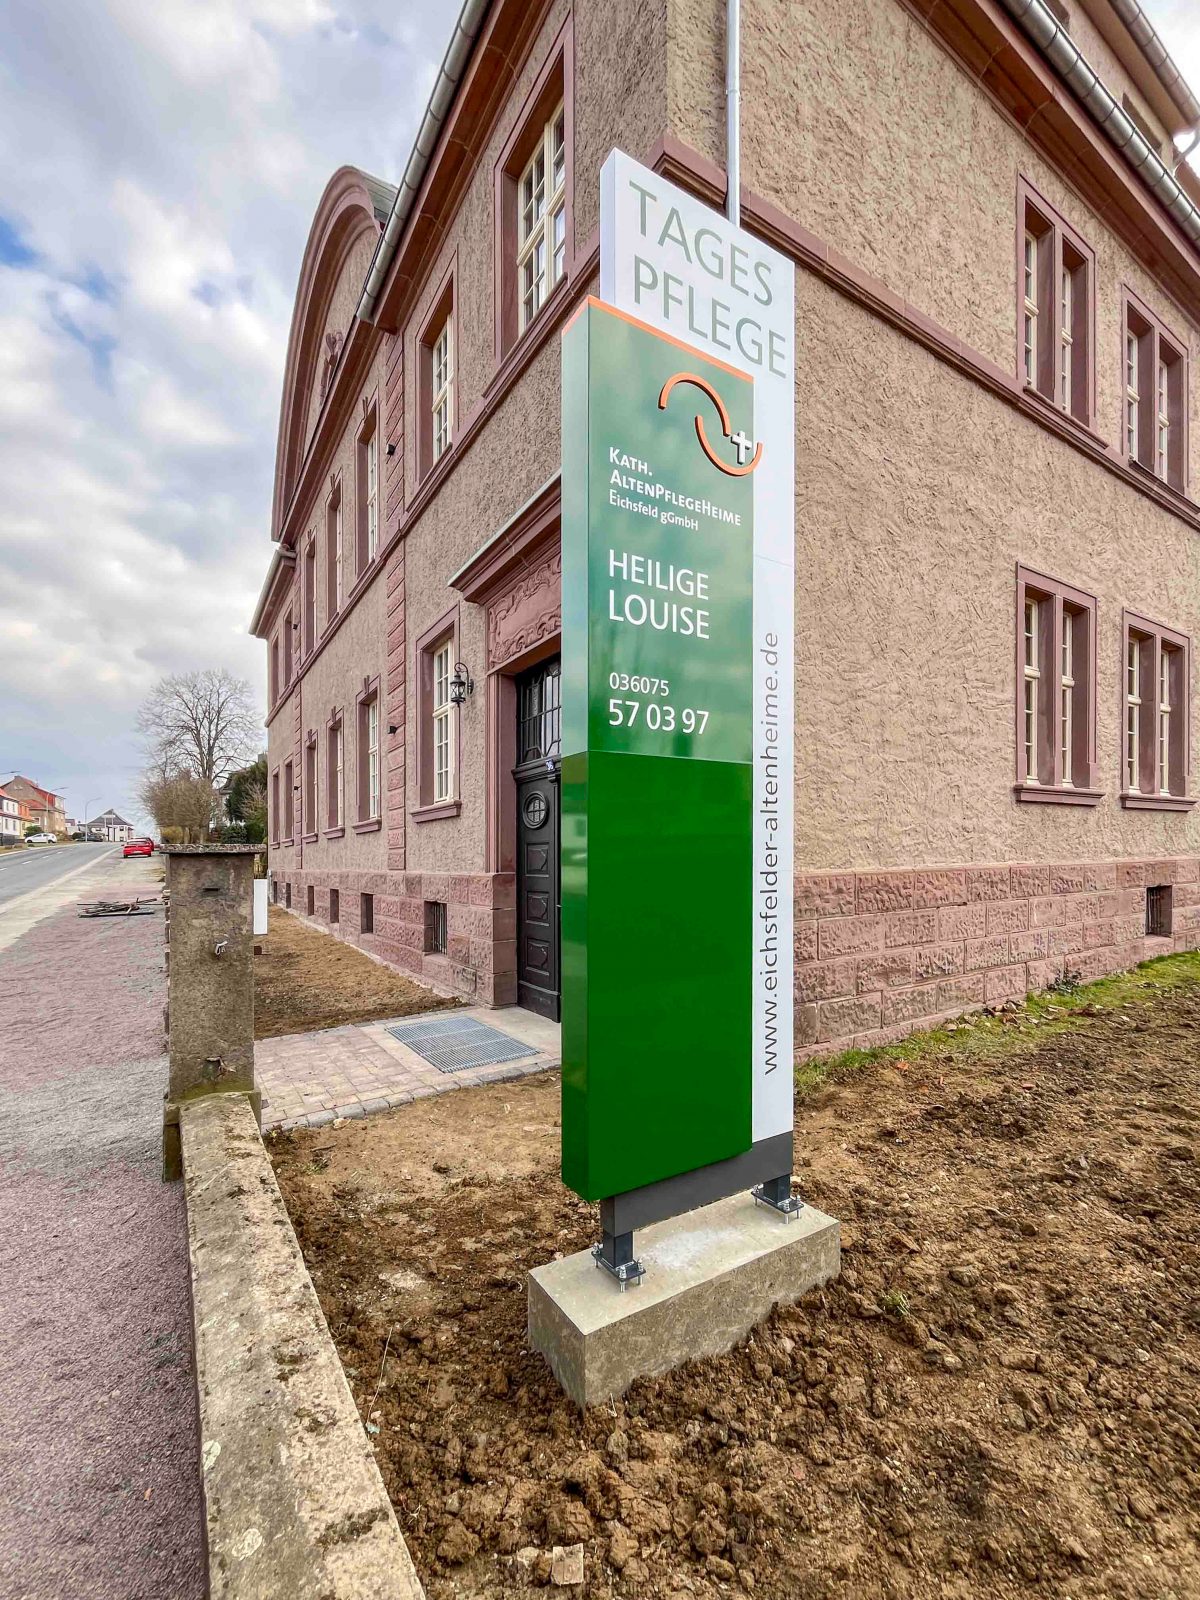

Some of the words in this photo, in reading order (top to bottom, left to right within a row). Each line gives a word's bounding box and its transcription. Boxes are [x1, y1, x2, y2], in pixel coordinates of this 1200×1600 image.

[629, 179, 773, 307] TAGES
[634, 253, 787, 379] PFLEGE
[609, 488, 658, 518] Eichsfeld
[660, 511, 699, 531] gGmbH
[609, 548, 709, 601] HEILIGE
[609, 589, 710, 640] LOUISE
[609, 672, 670, 696] 036075
[608, 698, 640, 727] 57
[646, 703, 676, 732] 03
[681, 708, 710, 735] 97
[760, 632, 778, 1076] www.eichsfelder-altenheime.de
